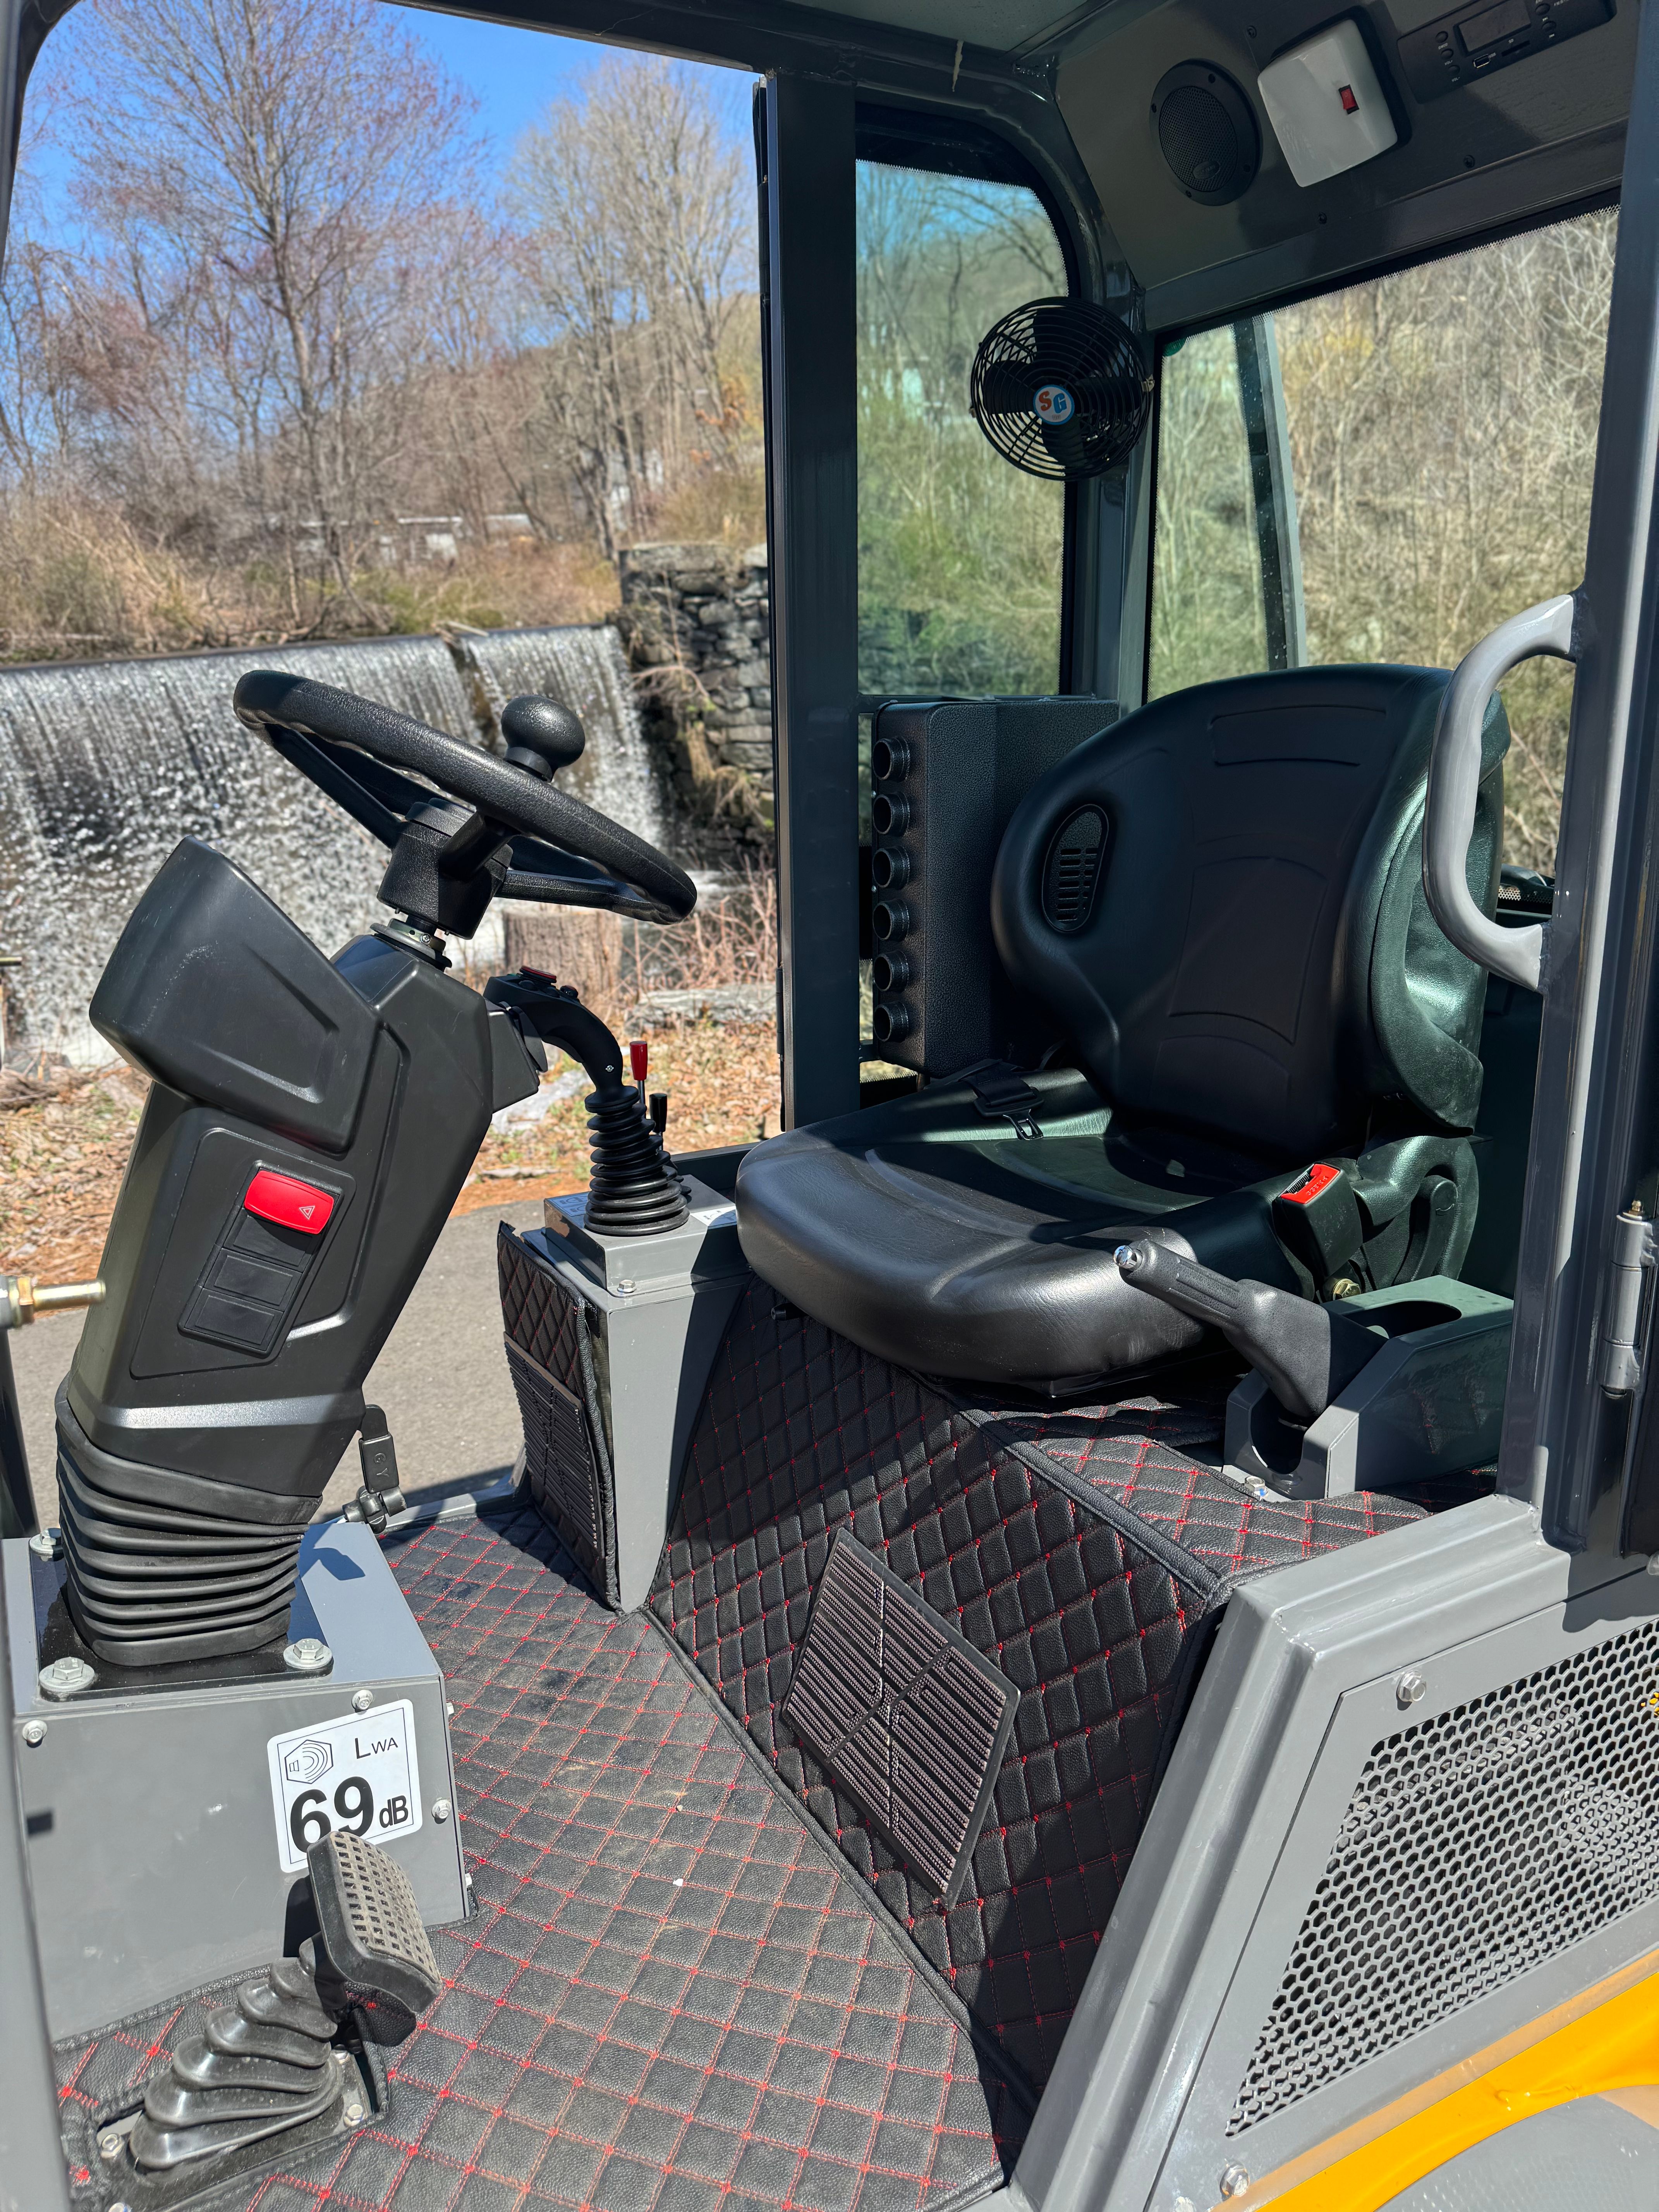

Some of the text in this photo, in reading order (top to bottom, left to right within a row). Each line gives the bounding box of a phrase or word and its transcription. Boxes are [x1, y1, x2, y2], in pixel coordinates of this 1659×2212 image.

[1039, 390, 1067, 414] SG
[1307, 1176, 1329, 1195] PRESS
[290, 1776, 409, 1853] 69 dB
